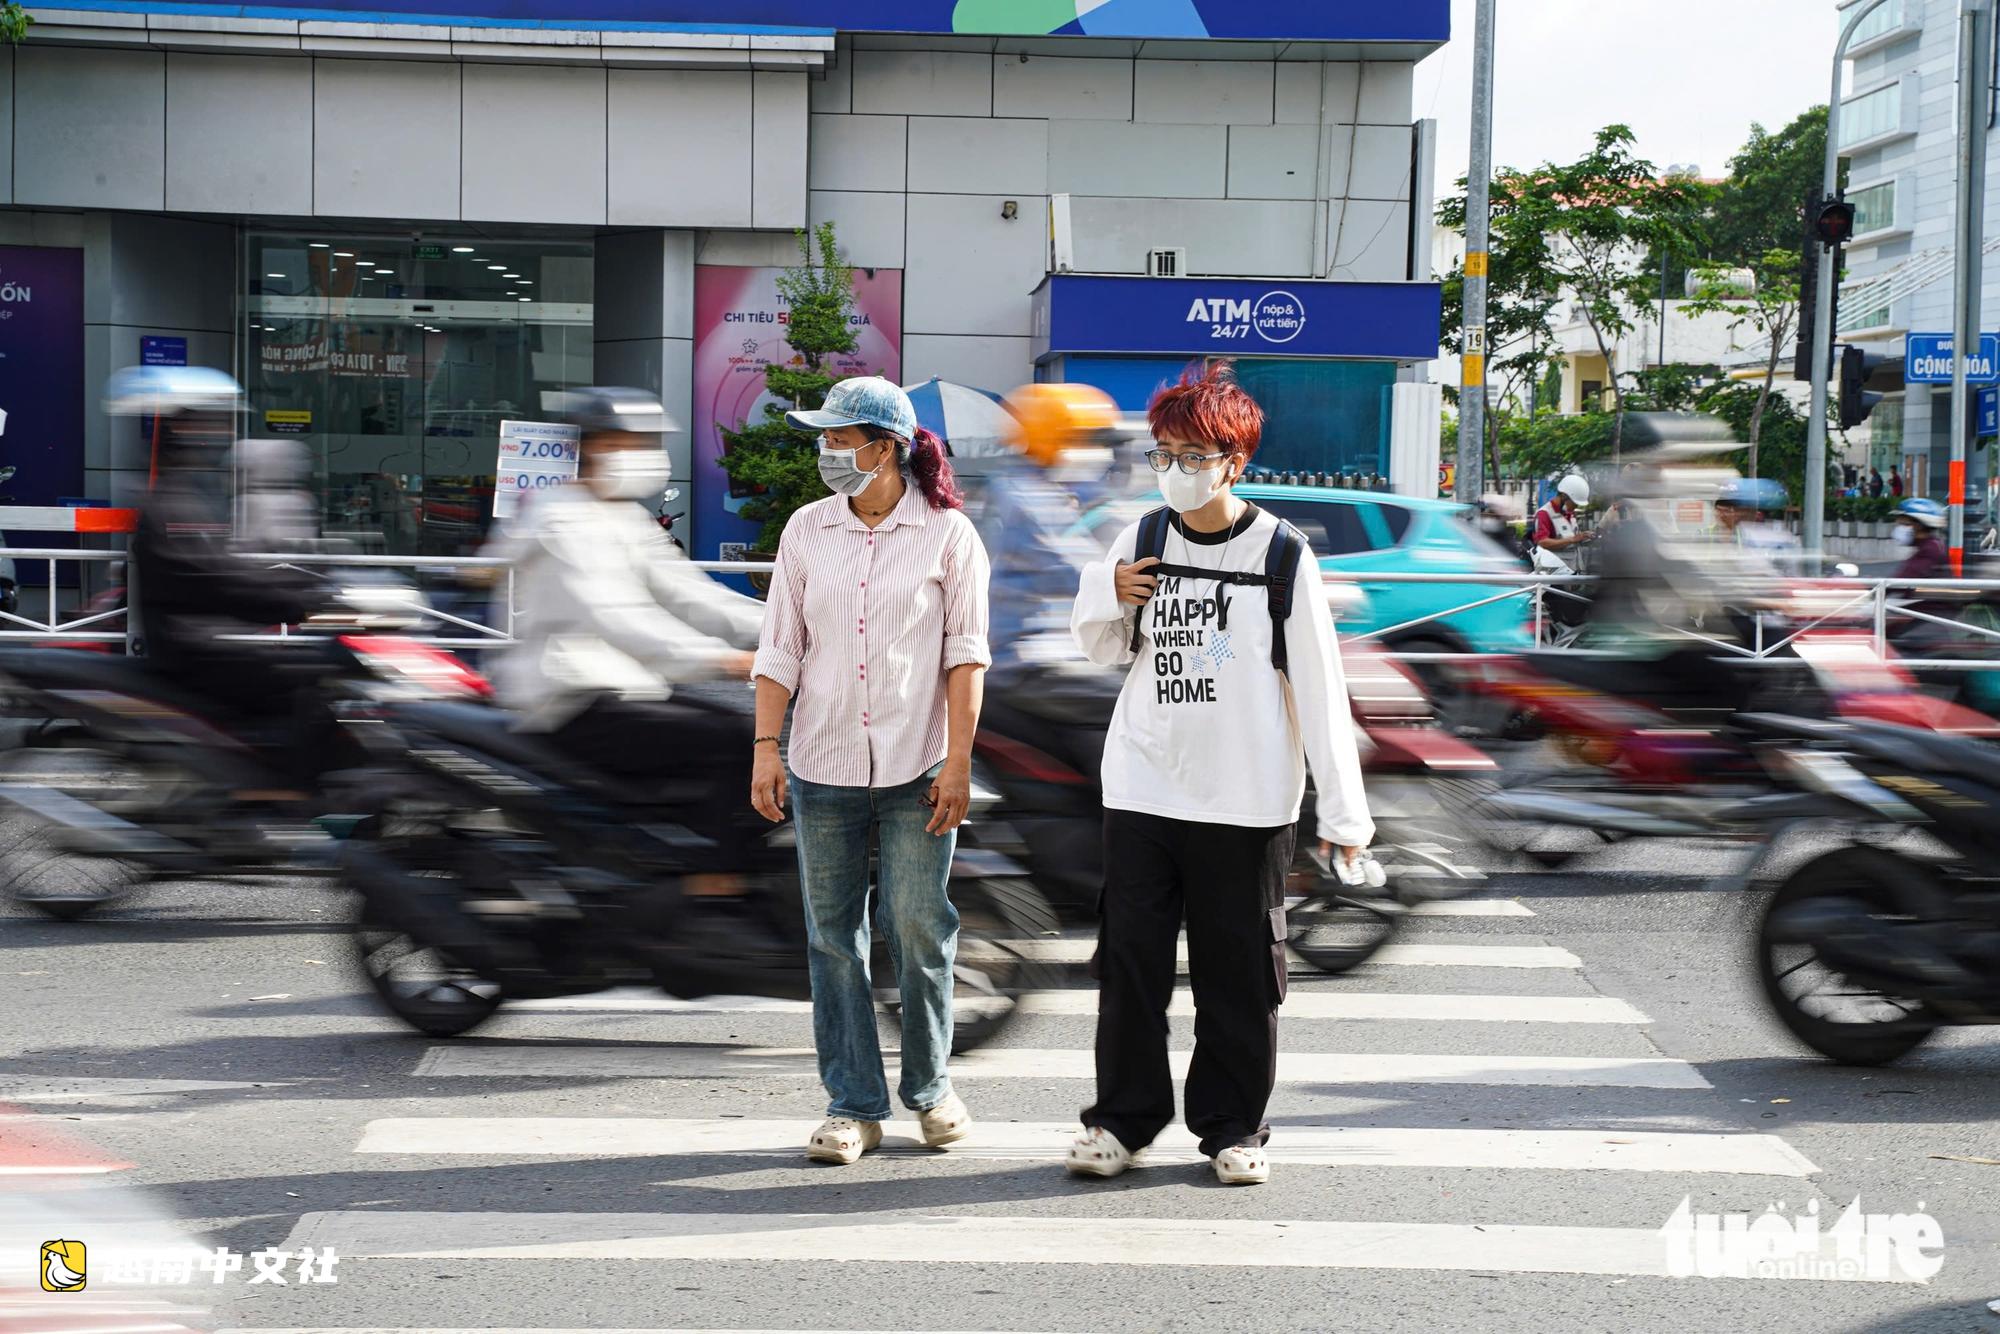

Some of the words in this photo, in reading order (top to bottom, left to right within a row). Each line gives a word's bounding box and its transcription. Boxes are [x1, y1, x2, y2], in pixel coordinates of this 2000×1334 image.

[0, 281, 31, 302] ỐN
[724, 312, 745, 323] CHI
[749, 310, 774, 323] TIÊU
[850, 313, 871, 326] GIÁ
[1186, 298, 1251, 323] ATM
[1263, 304, 1285, 317] nộp
[1211, 324, 1250, 339] 24/7
[1259, 318, 1275, 328] rút
[1468, 333, 1482, 347] 19
[1914, 355, 1953, 378] CỘNG
[501, 444, 518, 452] VND
[521, 441, 576, 460] 7.00%
[498, 476, 516, 485] USD
[1153, 596, 1232, 627] HAPPY
[1153, 630, 1195, 648] WHEN
[1196, 630, 1203, 647] I
[1154, 651, 1183, 677] GO
[1156, 678, 1217, 704] HOME
